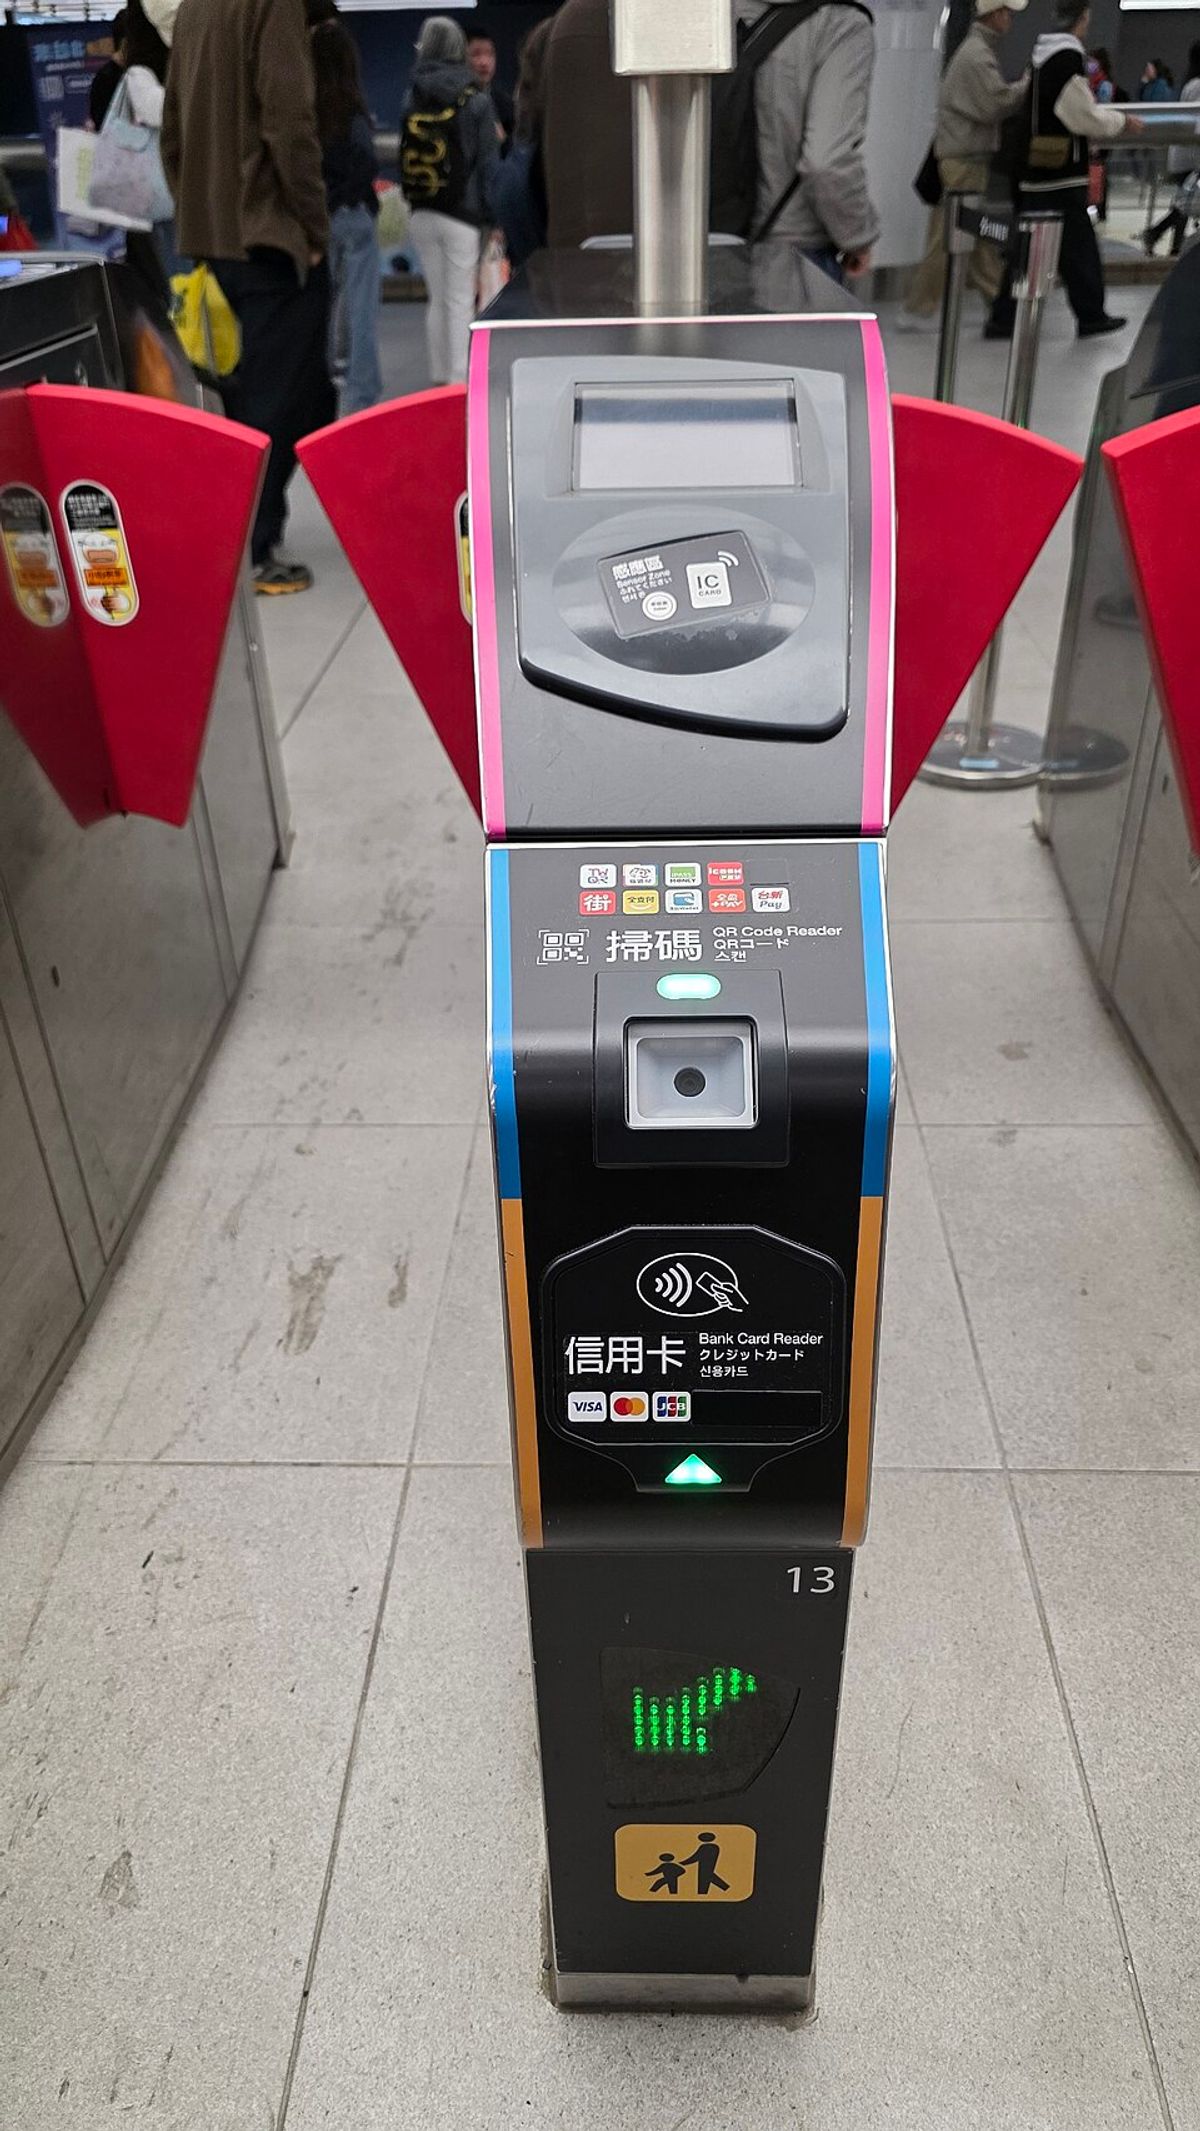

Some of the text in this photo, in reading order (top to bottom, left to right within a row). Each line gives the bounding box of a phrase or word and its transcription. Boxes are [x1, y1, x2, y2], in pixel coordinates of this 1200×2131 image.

[616, 569, 671, 588] Sensor Zone
[696, 575, 719, 589] IC
[583, 894, 611, 912] 街
[760, 901, 782, 910] Pay
[713, 926, 843, 938] QR Code Reader
[605, 930, 702, 963] 掃碼
[713, 939, 789, 950] QRコード
[714, 950, 747, 963] 스캔
[699, 1332, 824, 1345] Bank Card Reader
[565, 1335, 687, 1375] 信用卡
[699, 1348, 804, 1362] クレジットカード
[699, 1365, 749, 1378] 신용카드
[573, 1401, 603, 1412] VISA
[657, 1399, 687, 1414] JCB
[787, 1566, 835, 1593] 13
